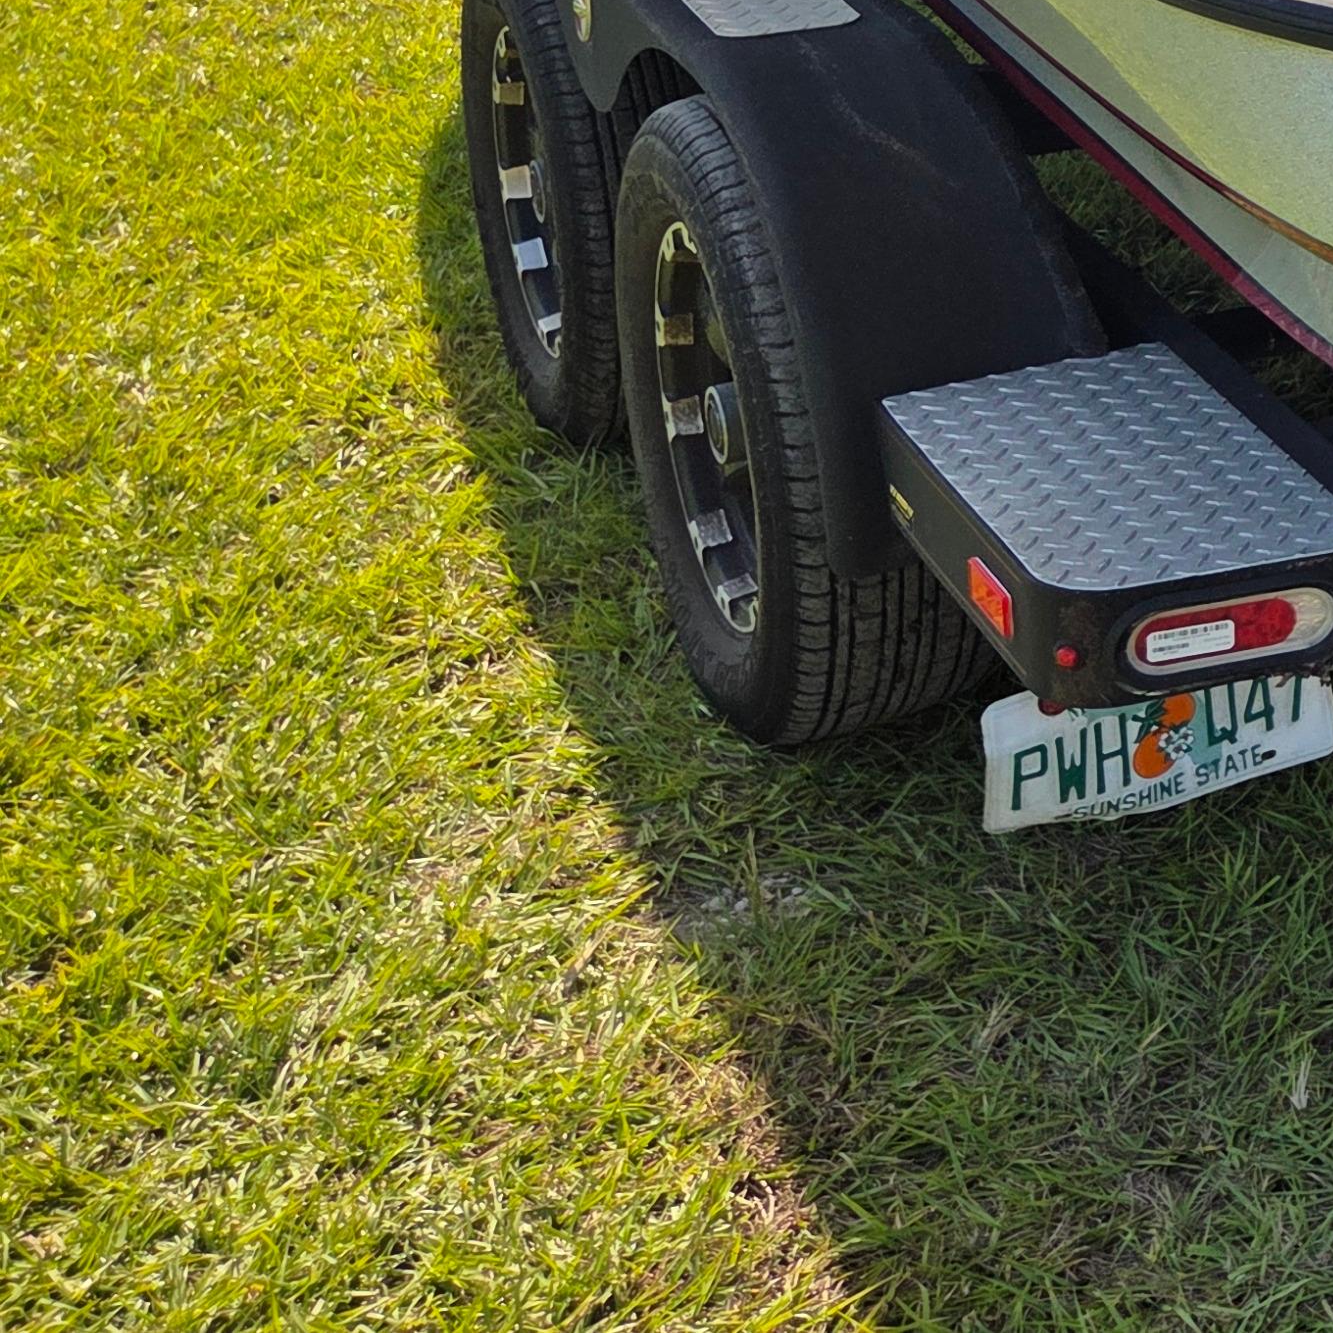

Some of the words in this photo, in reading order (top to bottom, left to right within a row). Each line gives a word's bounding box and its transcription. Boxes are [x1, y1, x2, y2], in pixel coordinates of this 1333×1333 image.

[1011, 713, 1131, 811] PWH
[1071, 775, 1187, 820] SUNSHINE
[1195, 744, 1265, 787] STATE
